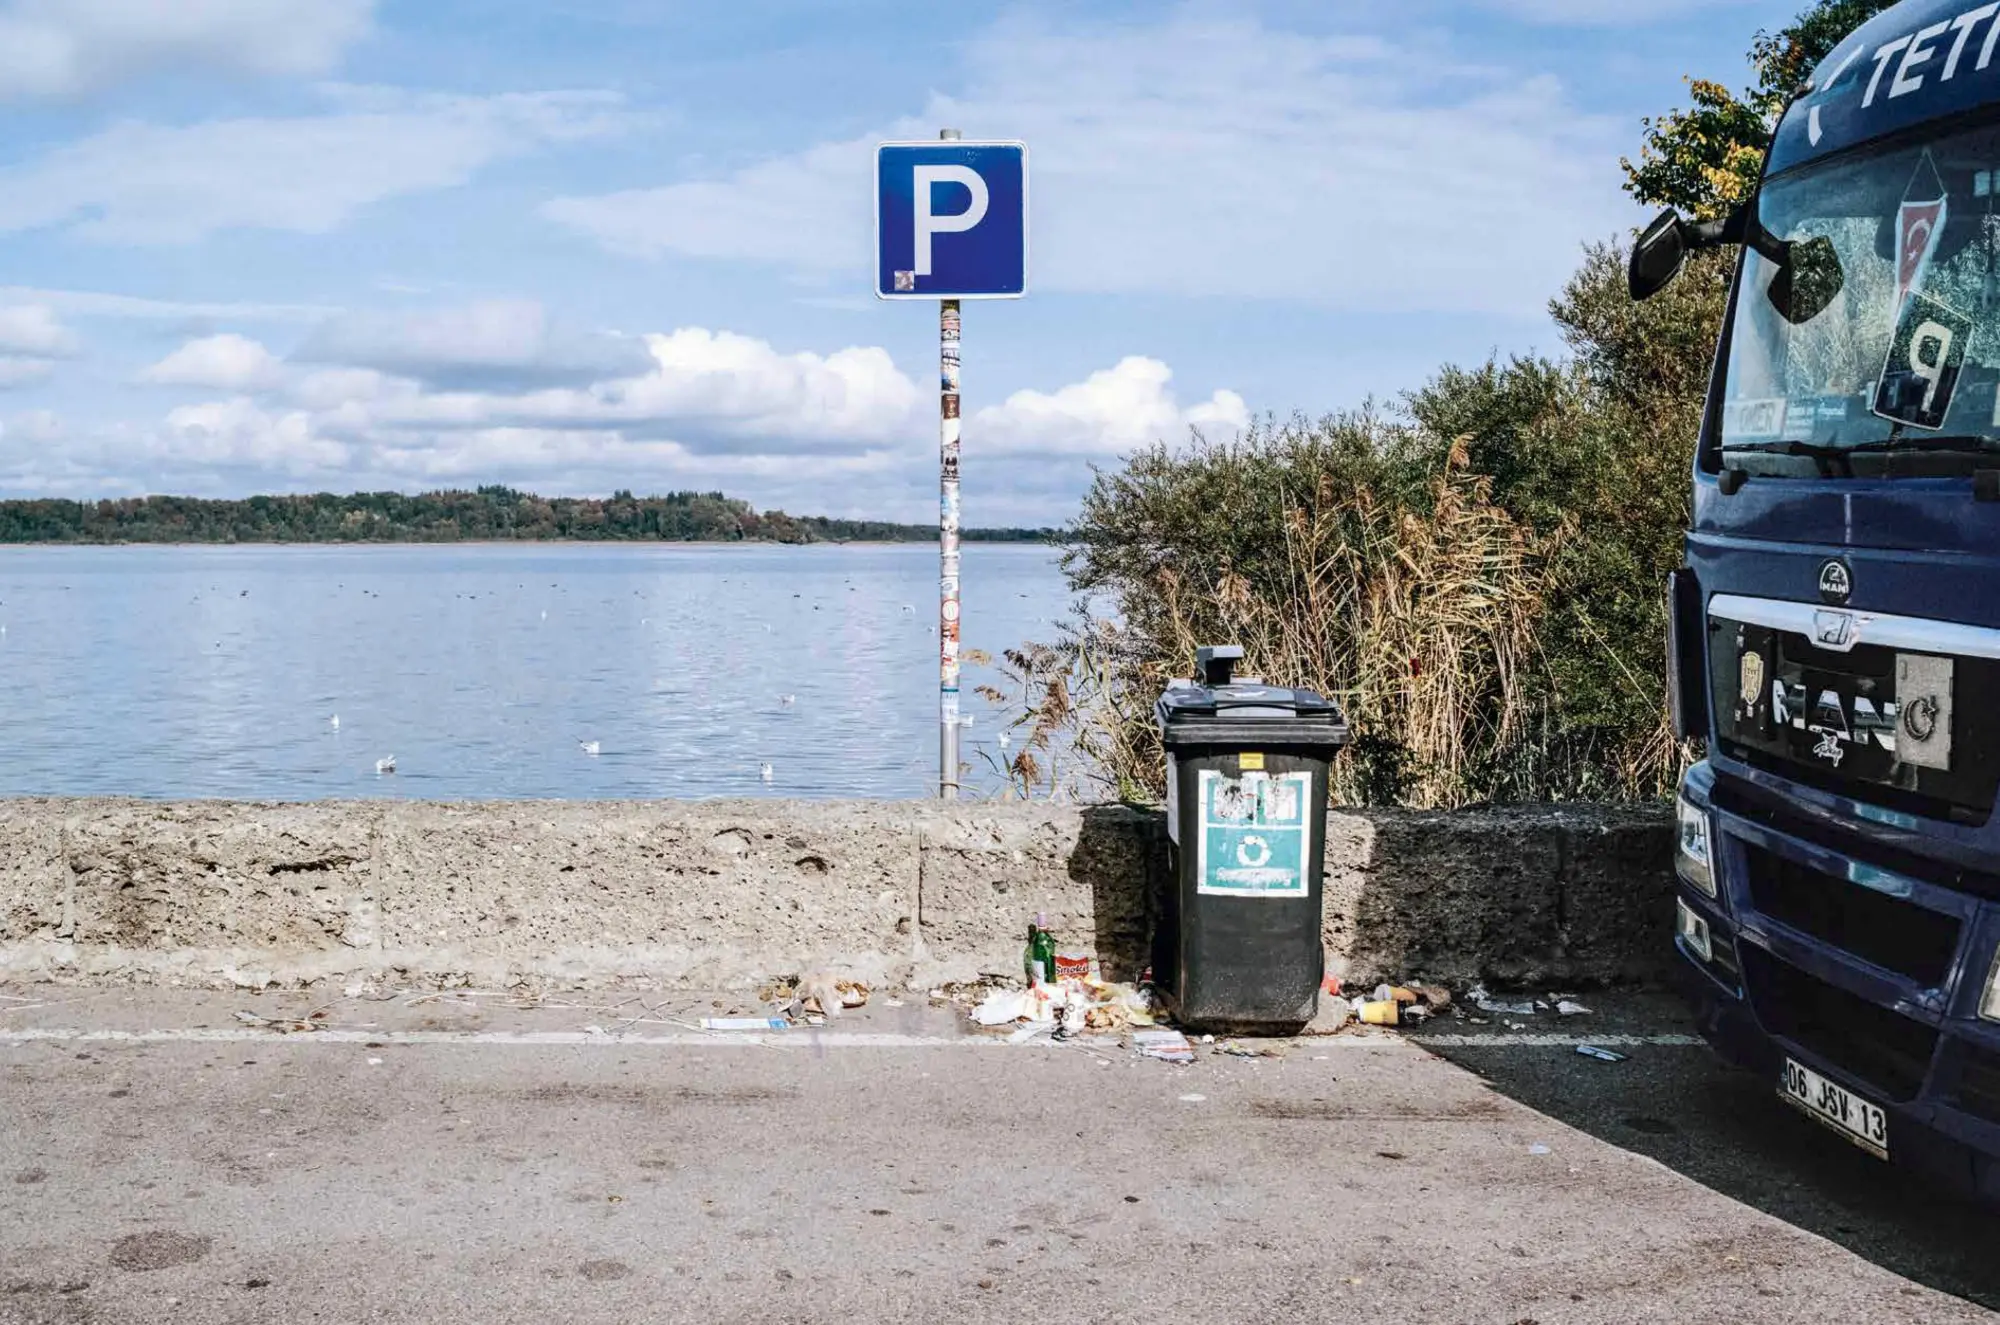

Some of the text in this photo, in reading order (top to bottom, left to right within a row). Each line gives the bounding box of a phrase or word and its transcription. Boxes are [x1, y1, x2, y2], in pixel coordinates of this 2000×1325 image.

[914, 164, 989, 276] P
[1822, 582, 1847, 594] MAN
[1773, 679, 1896, 751] MAN
[1789, 1062, 1884, 1141] 06 JSV 13
